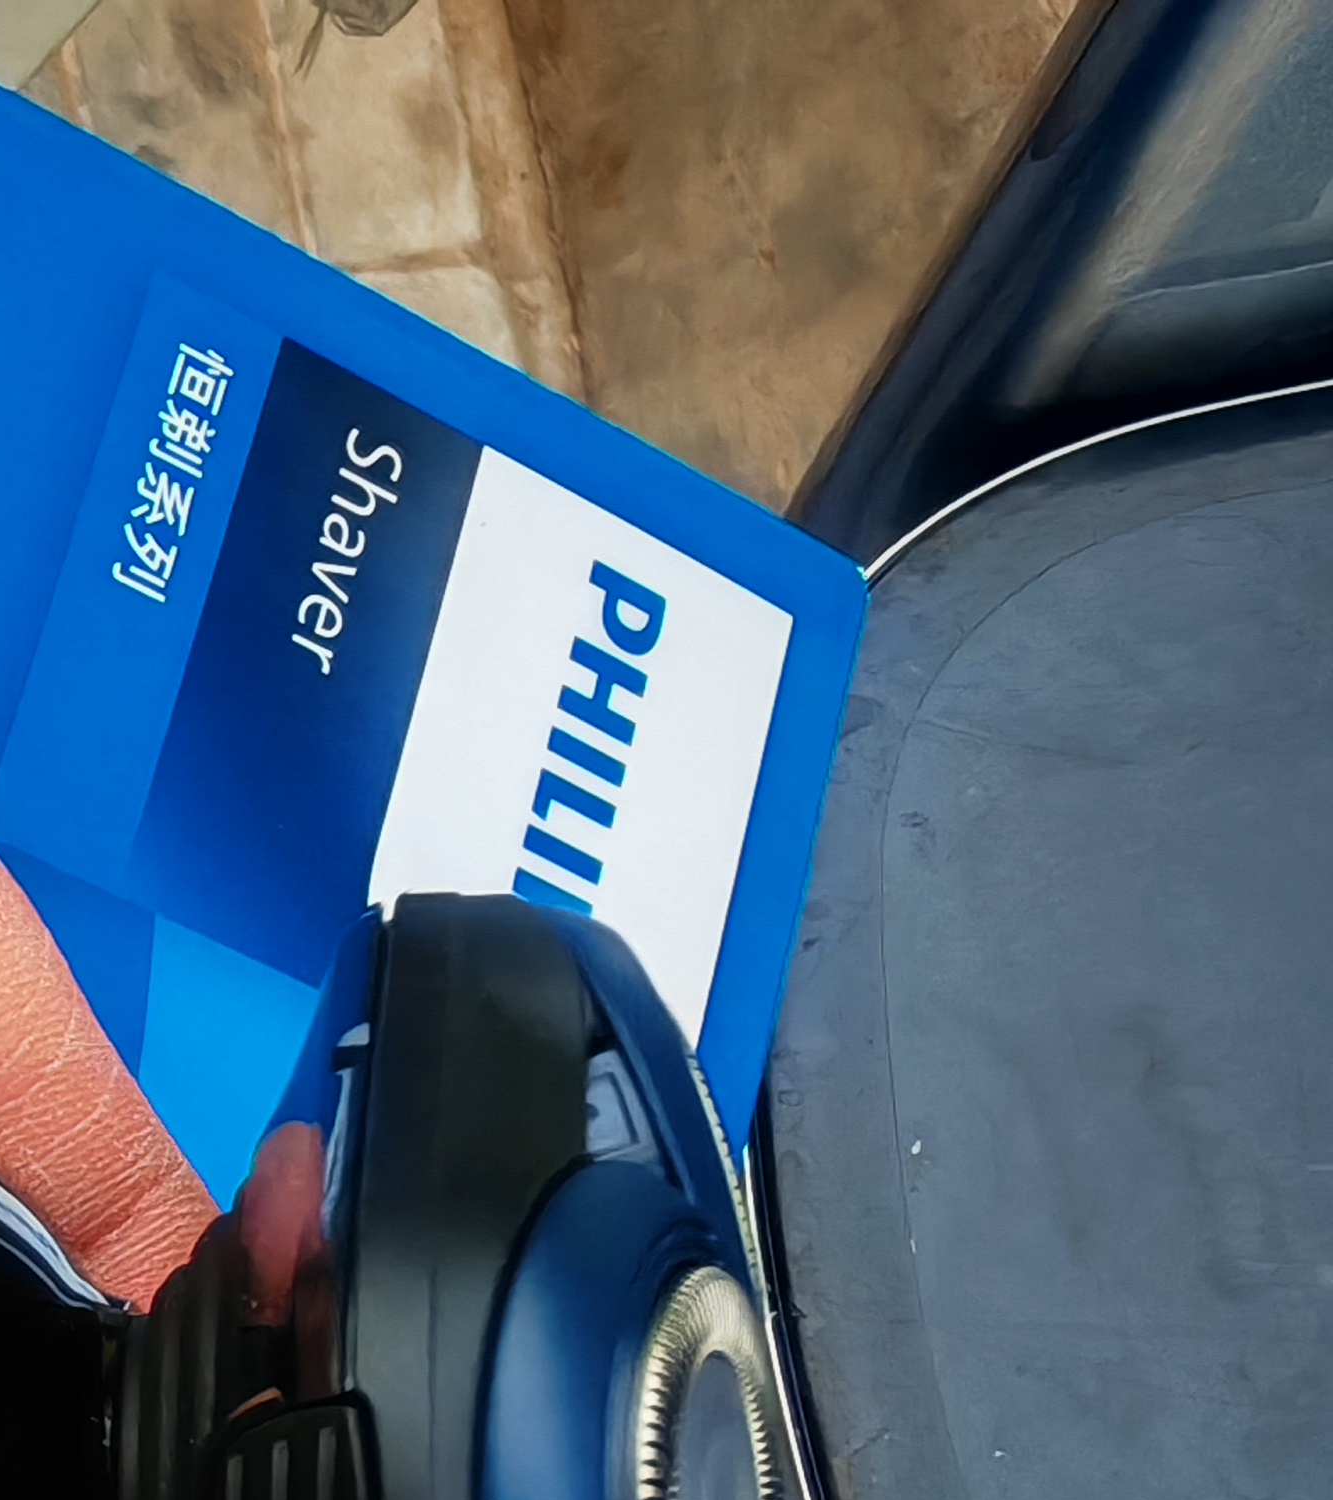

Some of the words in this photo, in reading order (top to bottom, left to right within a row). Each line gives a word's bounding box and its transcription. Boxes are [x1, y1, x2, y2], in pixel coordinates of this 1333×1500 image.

[112, 343, 235, 603] 恒剃系列
[291, 427, 403, 676] Shaver
